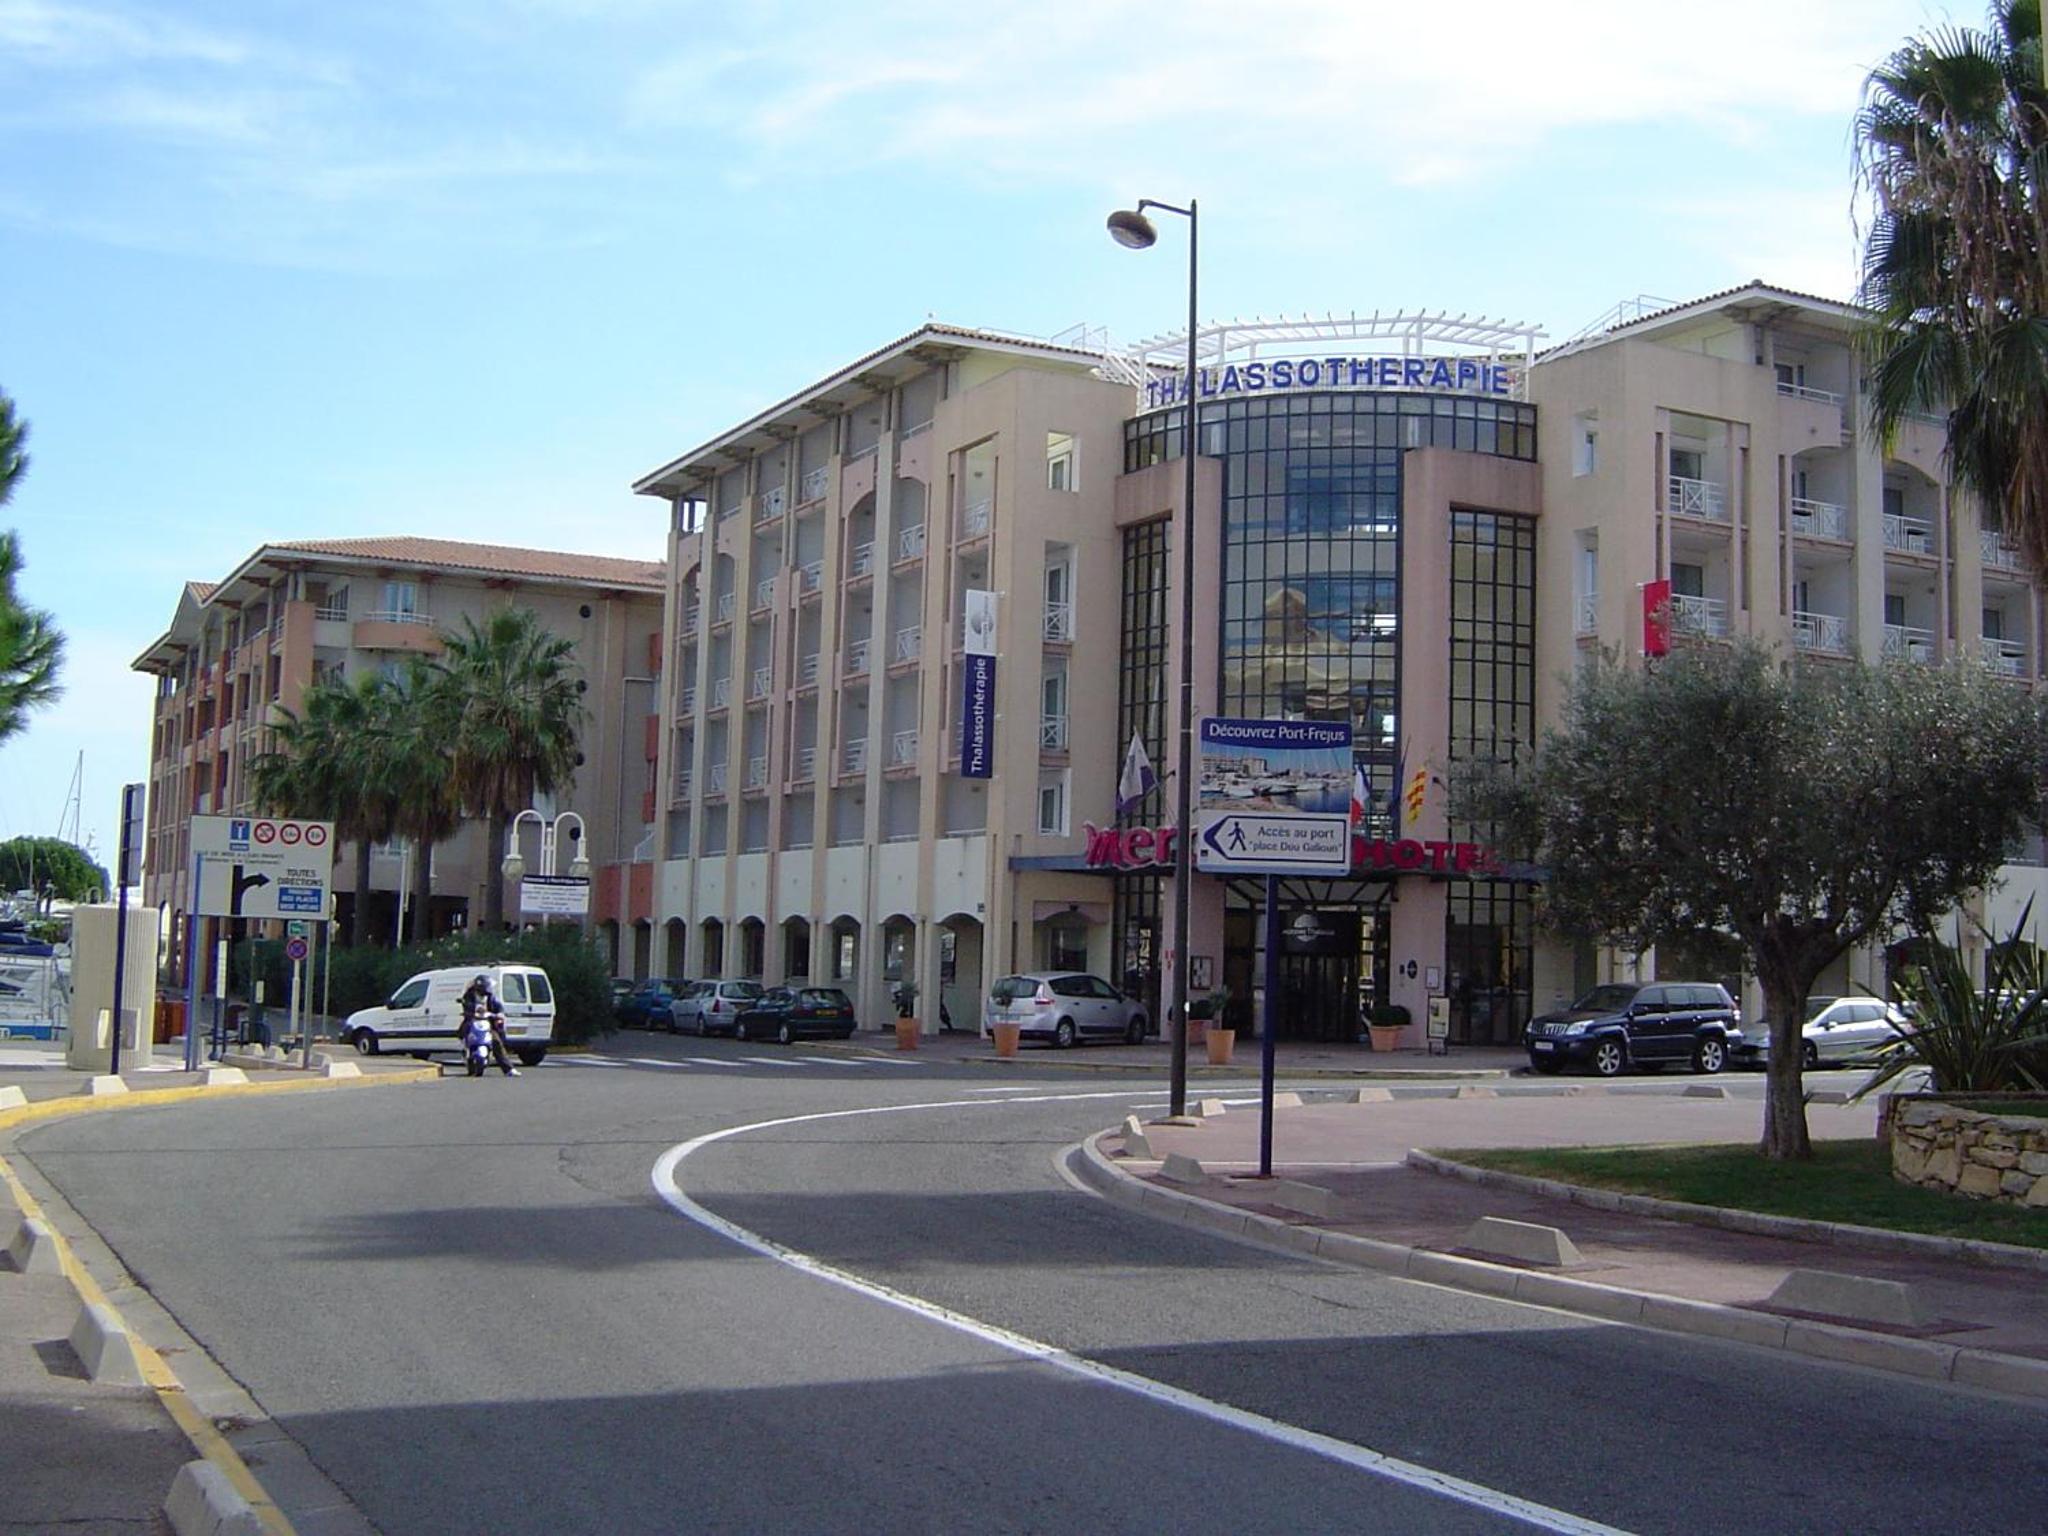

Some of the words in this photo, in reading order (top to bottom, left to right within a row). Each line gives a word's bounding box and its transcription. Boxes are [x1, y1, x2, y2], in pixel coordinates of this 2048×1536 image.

[1146, 356, 1508, 408] THALASSOTHERAPIE
[1209, 723, 1275, 739] Découvrez
[1310, 828, 1334, 841] port
